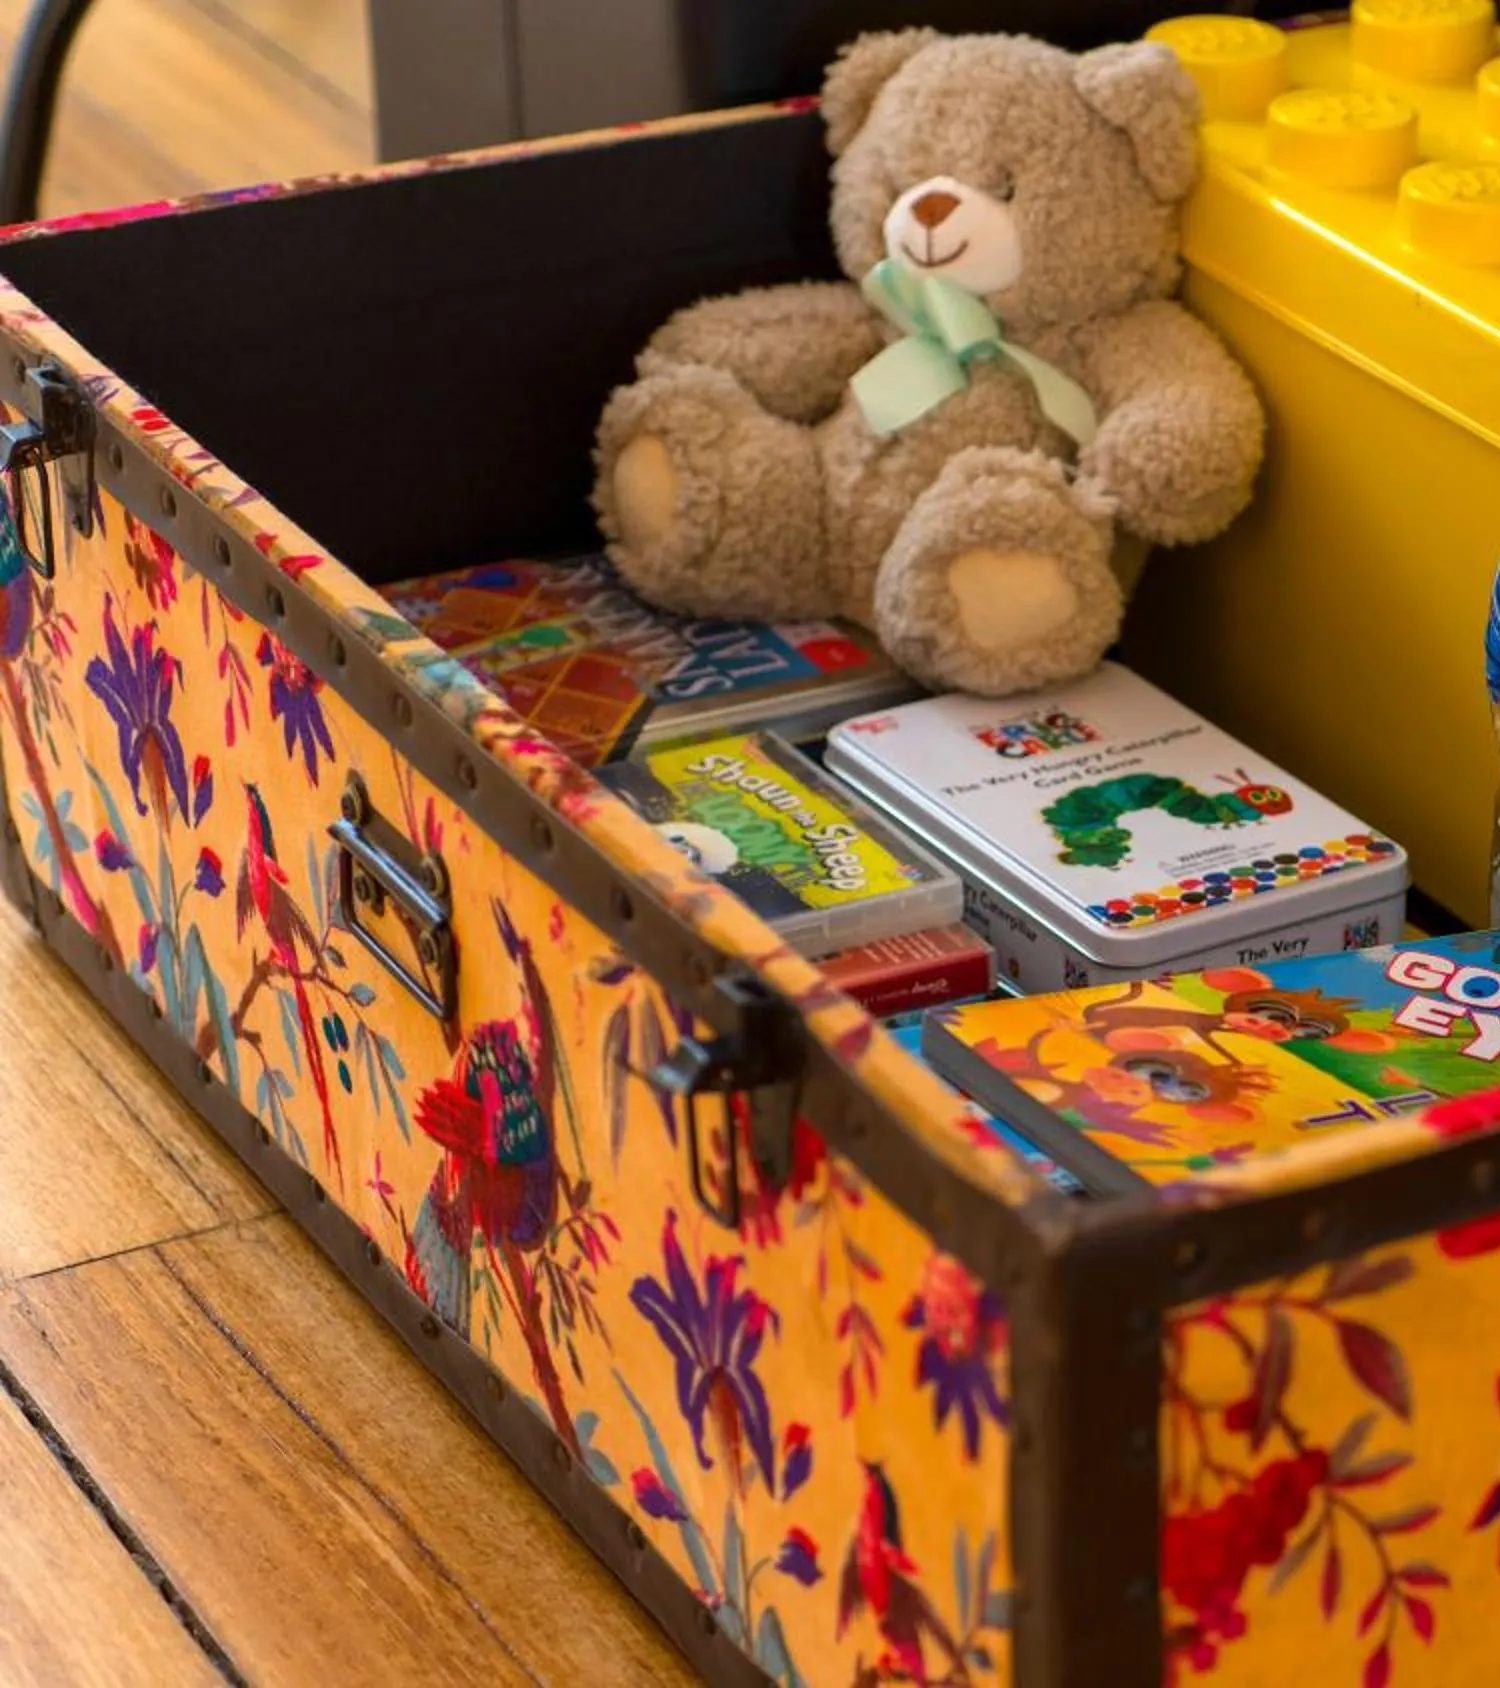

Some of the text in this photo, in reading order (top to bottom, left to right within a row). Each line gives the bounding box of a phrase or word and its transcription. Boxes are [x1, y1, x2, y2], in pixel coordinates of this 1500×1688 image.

[942, 725, 1203, 798] The Very Hungry Caterpillar
[1033, 757, 1144, 790] Card Game
[686, 754, 801, 812] Shaun
[804, 823, 867, 891] Sheep
[1236, 936, 1311, 965] The Very
